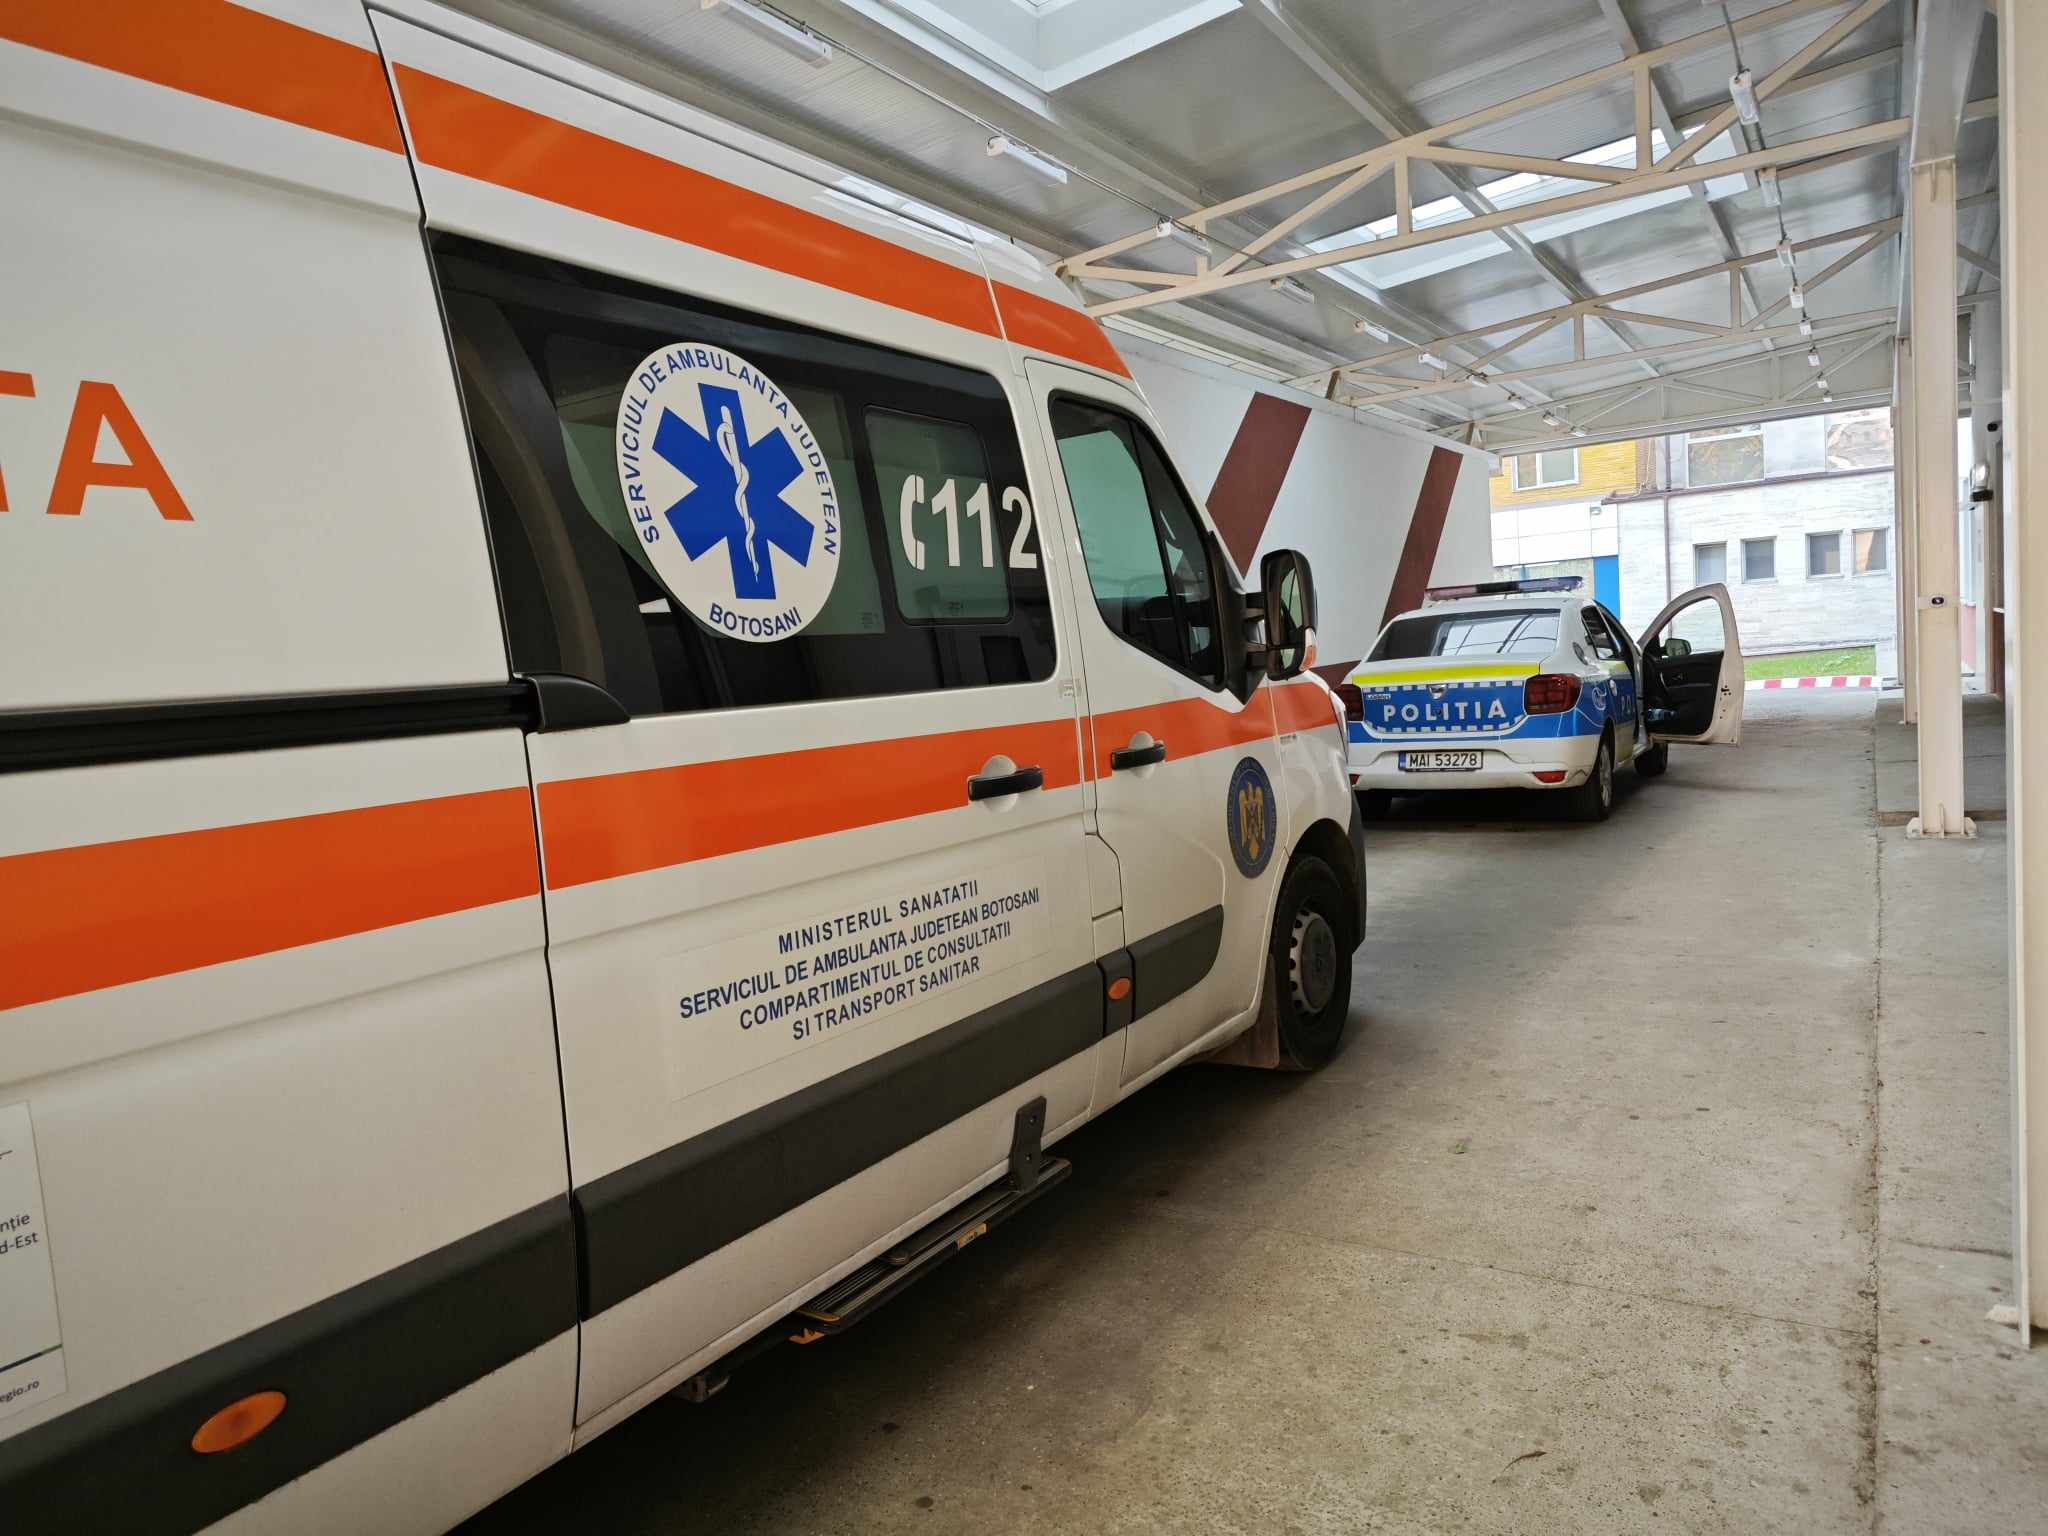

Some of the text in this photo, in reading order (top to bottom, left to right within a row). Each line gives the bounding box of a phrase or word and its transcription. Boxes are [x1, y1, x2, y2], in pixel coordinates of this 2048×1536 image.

[622, 348, 837, 556] SERVICIUL DE AMBULANTA JUDETEAN
[709, 602, 802, 638] BOTOSANI
[1383, 698, 1507, 722] POLITIA
[1409, 753, 1478, 767] MAI 53278
[680, 887, 1039, 1018] SERVICIUL DE AMBULANTA JUDETEAN BOTOSANI
[778, 879, 978, 954] MINISTERUL SANATATII
[739, 921, 1011, 1030] COMPARTIMENTUL DE CONSULTATII
[792, 955, 980, 1040] SI TRANSPORT SANITAR
